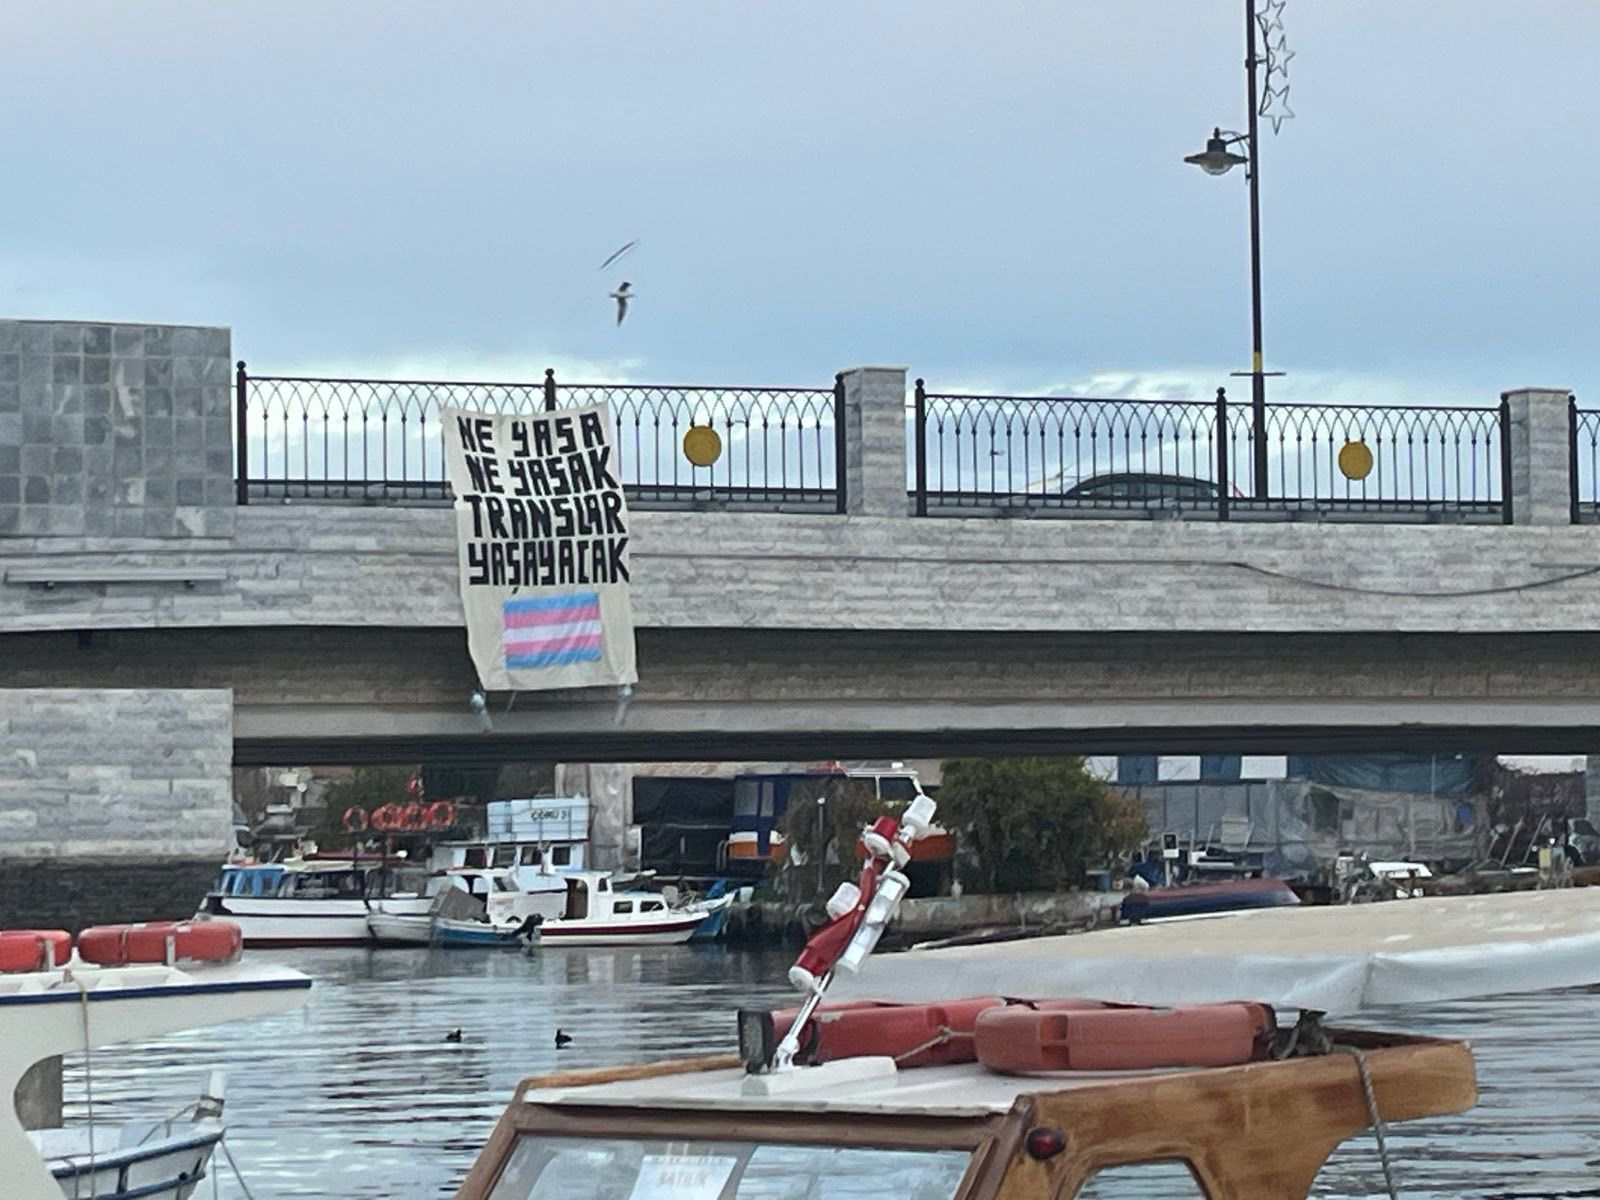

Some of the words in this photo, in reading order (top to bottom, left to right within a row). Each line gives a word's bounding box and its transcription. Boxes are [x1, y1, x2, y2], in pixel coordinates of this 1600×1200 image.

[457, 415, 496, 454] NE
[511, 411, 604, 457] YASA
[465, 454, 505, 493] NE
[508, 446, 619, 496] YASAK
[463, 491, 626, 539] TRANSLAR
